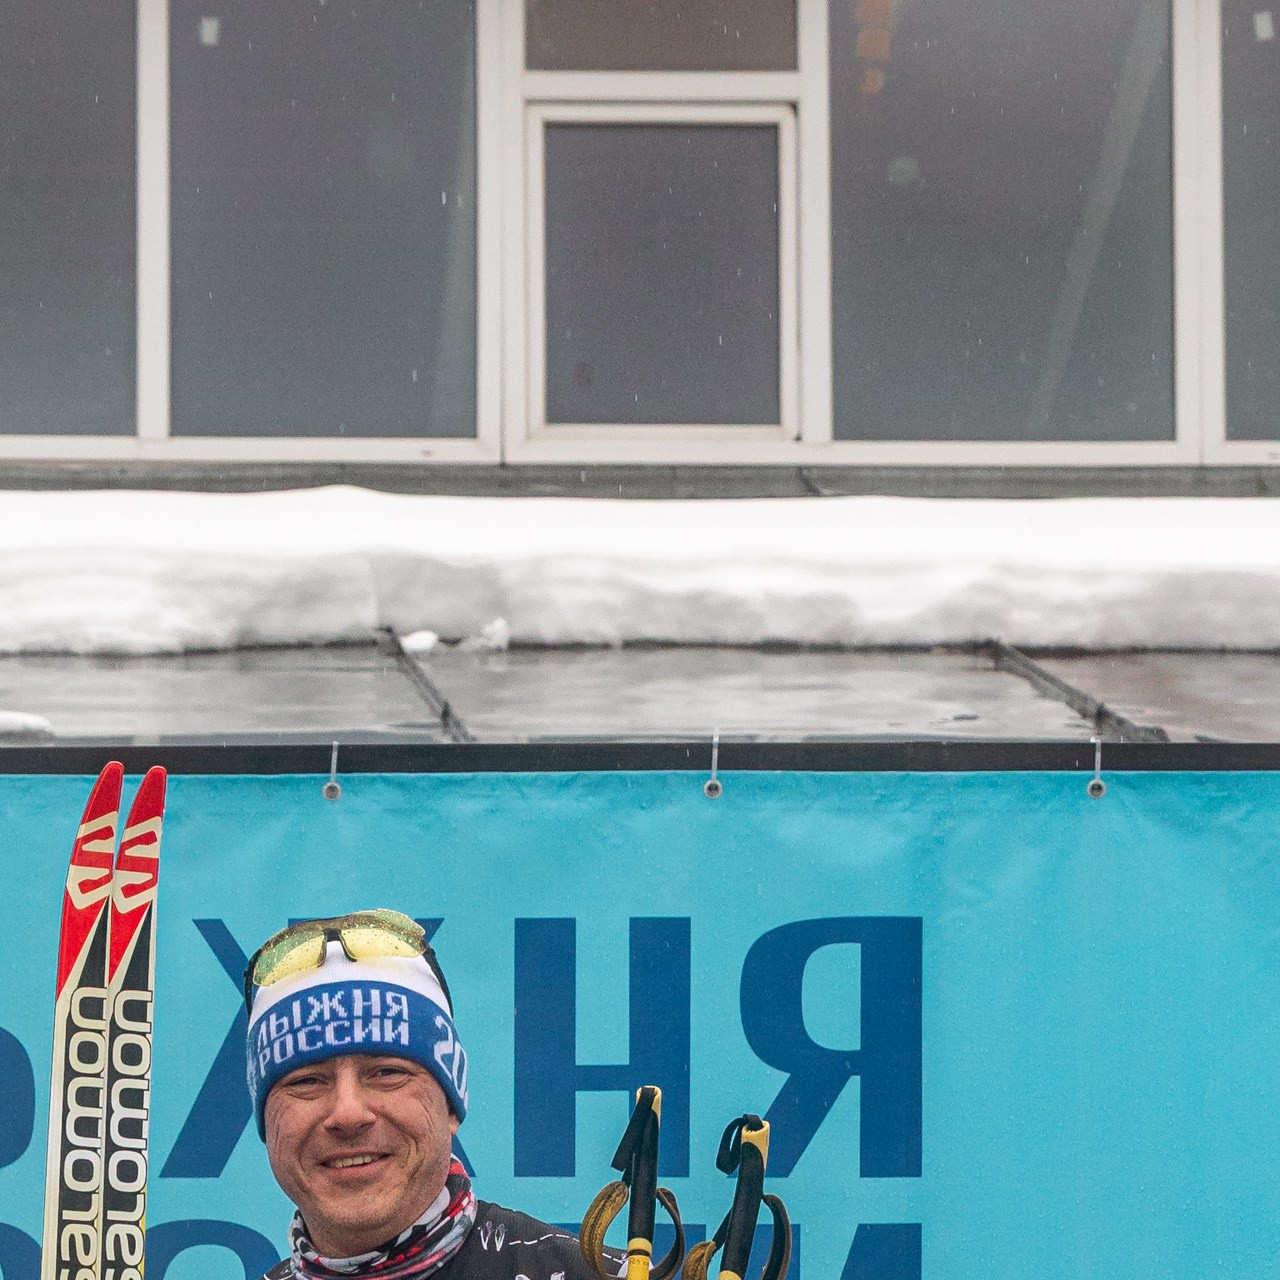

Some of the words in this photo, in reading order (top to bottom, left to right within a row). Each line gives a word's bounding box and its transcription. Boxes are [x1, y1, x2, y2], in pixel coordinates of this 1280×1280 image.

[257, 988, 410, 1053] ЛЫЖНЯ
[258, 1018, 410, 1079] РОССИИ
[433, 1013, 468, 1110] 20
